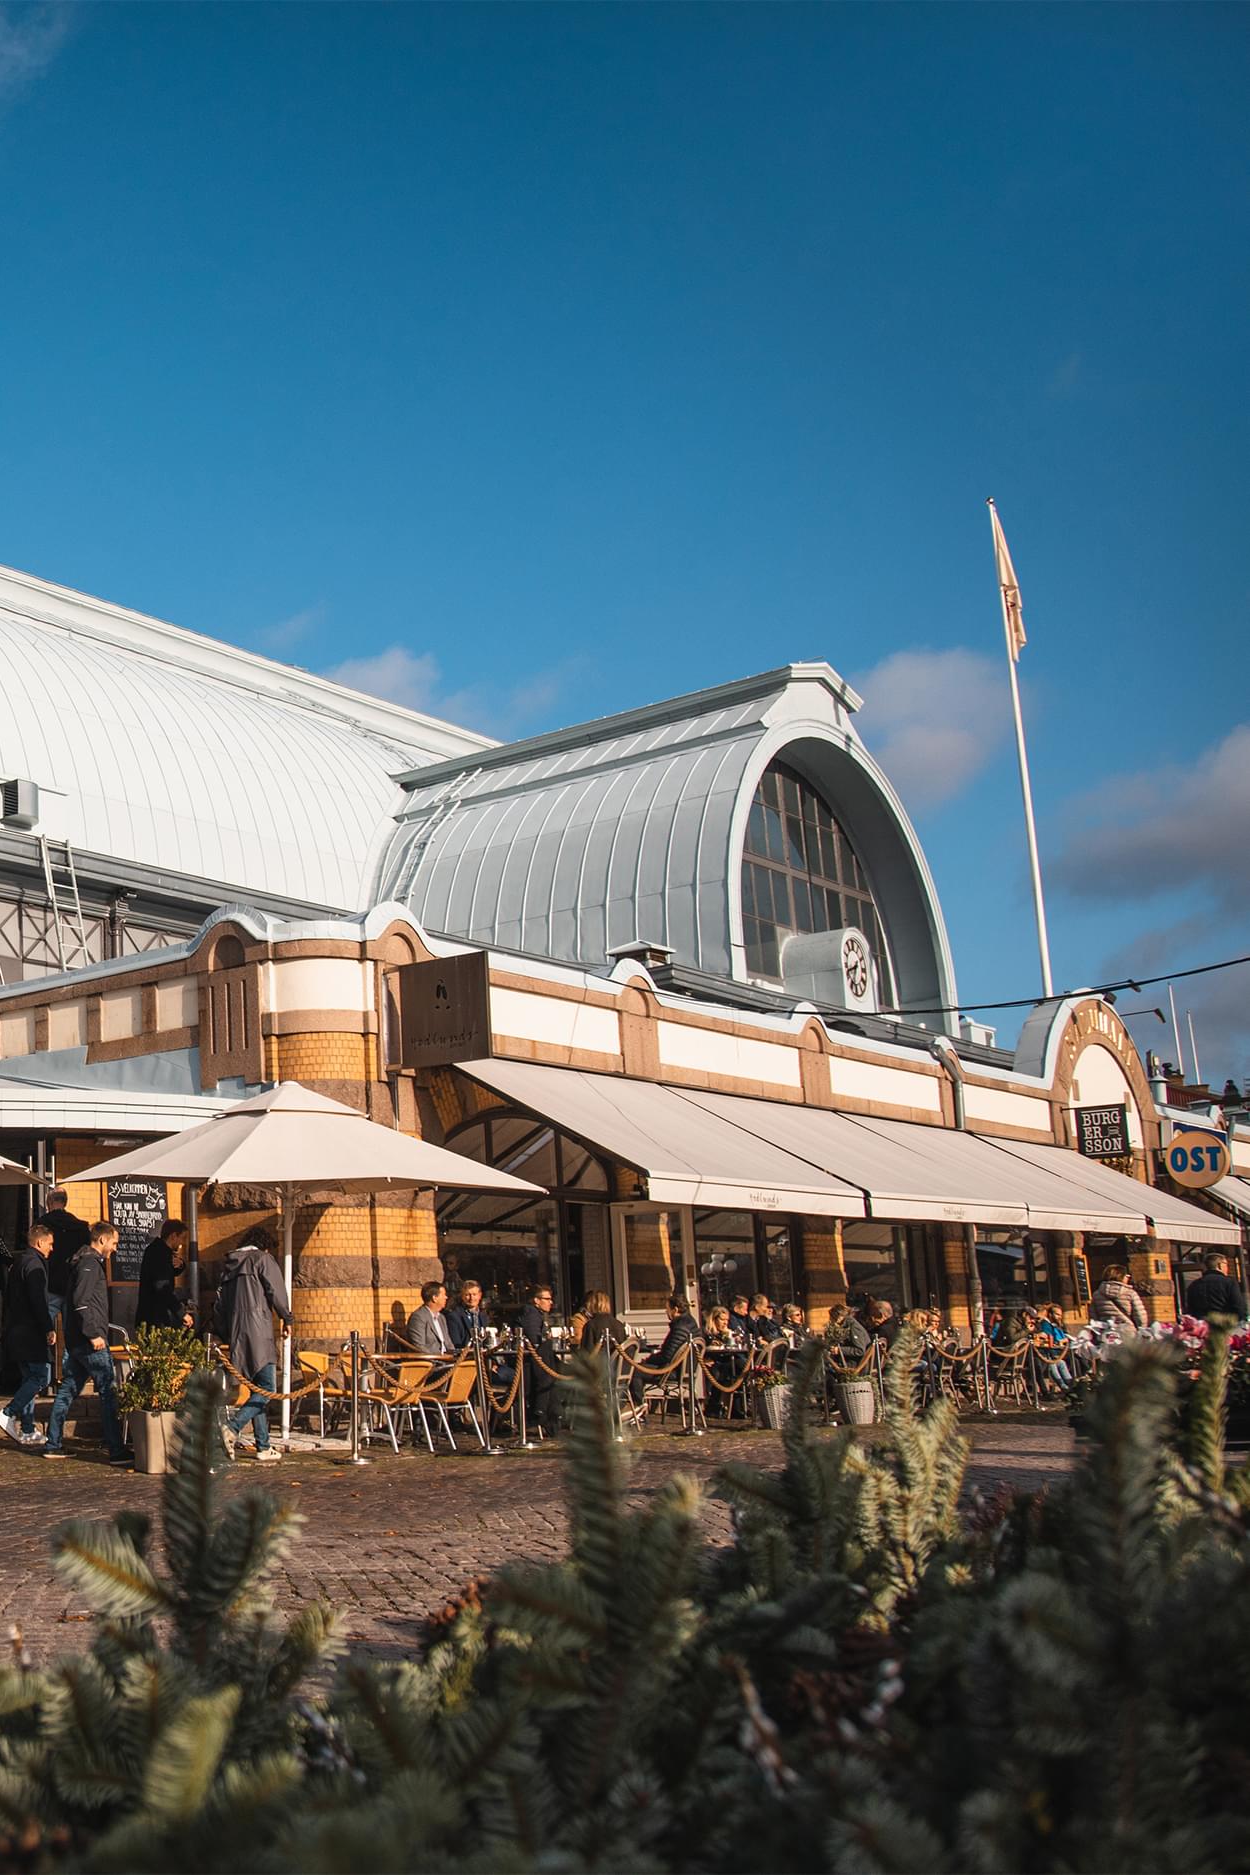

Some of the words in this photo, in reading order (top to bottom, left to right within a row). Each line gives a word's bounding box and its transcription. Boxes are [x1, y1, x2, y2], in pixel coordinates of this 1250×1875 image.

[1081, 1111, 1121, 1127] BURG
[1083, 1126, 1103, 1139] ER
[1085, 1138, 1122, 1152] SSON
[1170, 1146, 1221, 1172] OST
